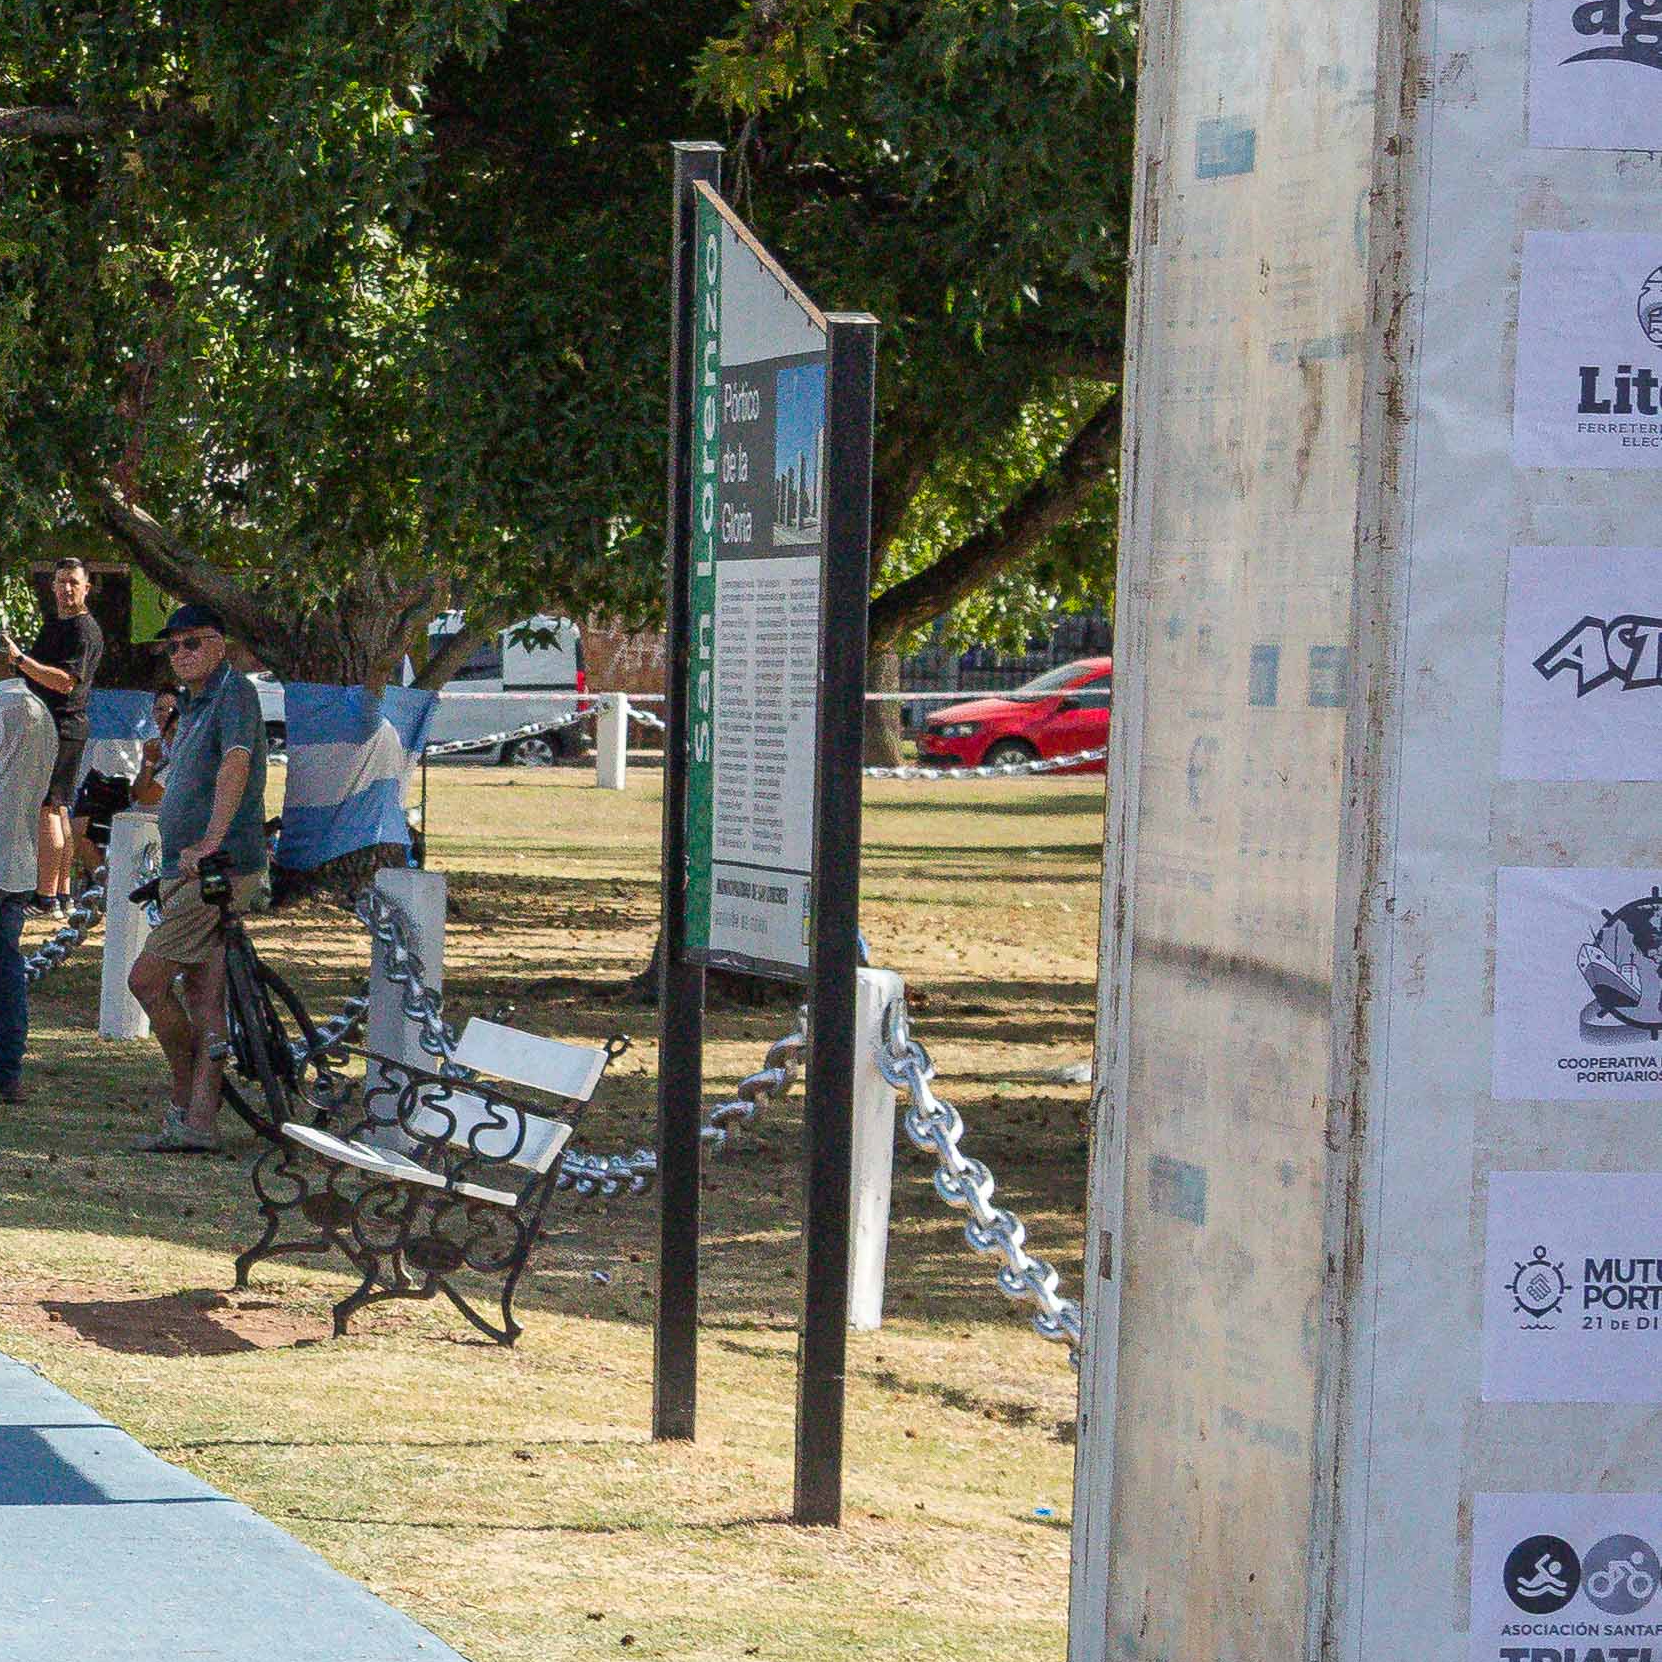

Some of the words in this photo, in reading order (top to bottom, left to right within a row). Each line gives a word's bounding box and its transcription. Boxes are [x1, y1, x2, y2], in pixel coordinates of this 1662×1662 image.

[1578, 365, 1662, 415] Lit
[697, 233, 719, 577] Lorenzo
[1578, 423, 1662, 434] FERRETER
[1622, 437, 1662, 447] ELEC
[694, 614, 711, 763] San
[1558, 1056, 1658, 1069] COOPERATIVA
[1583, 1285, 1662, 1310] PORT
[1582, 1316, 1603, 1330] 21
[1610, 1320, 1630, 1331] DE
[1500, 1621, 1599, 1636] ASOCIACIÓN
